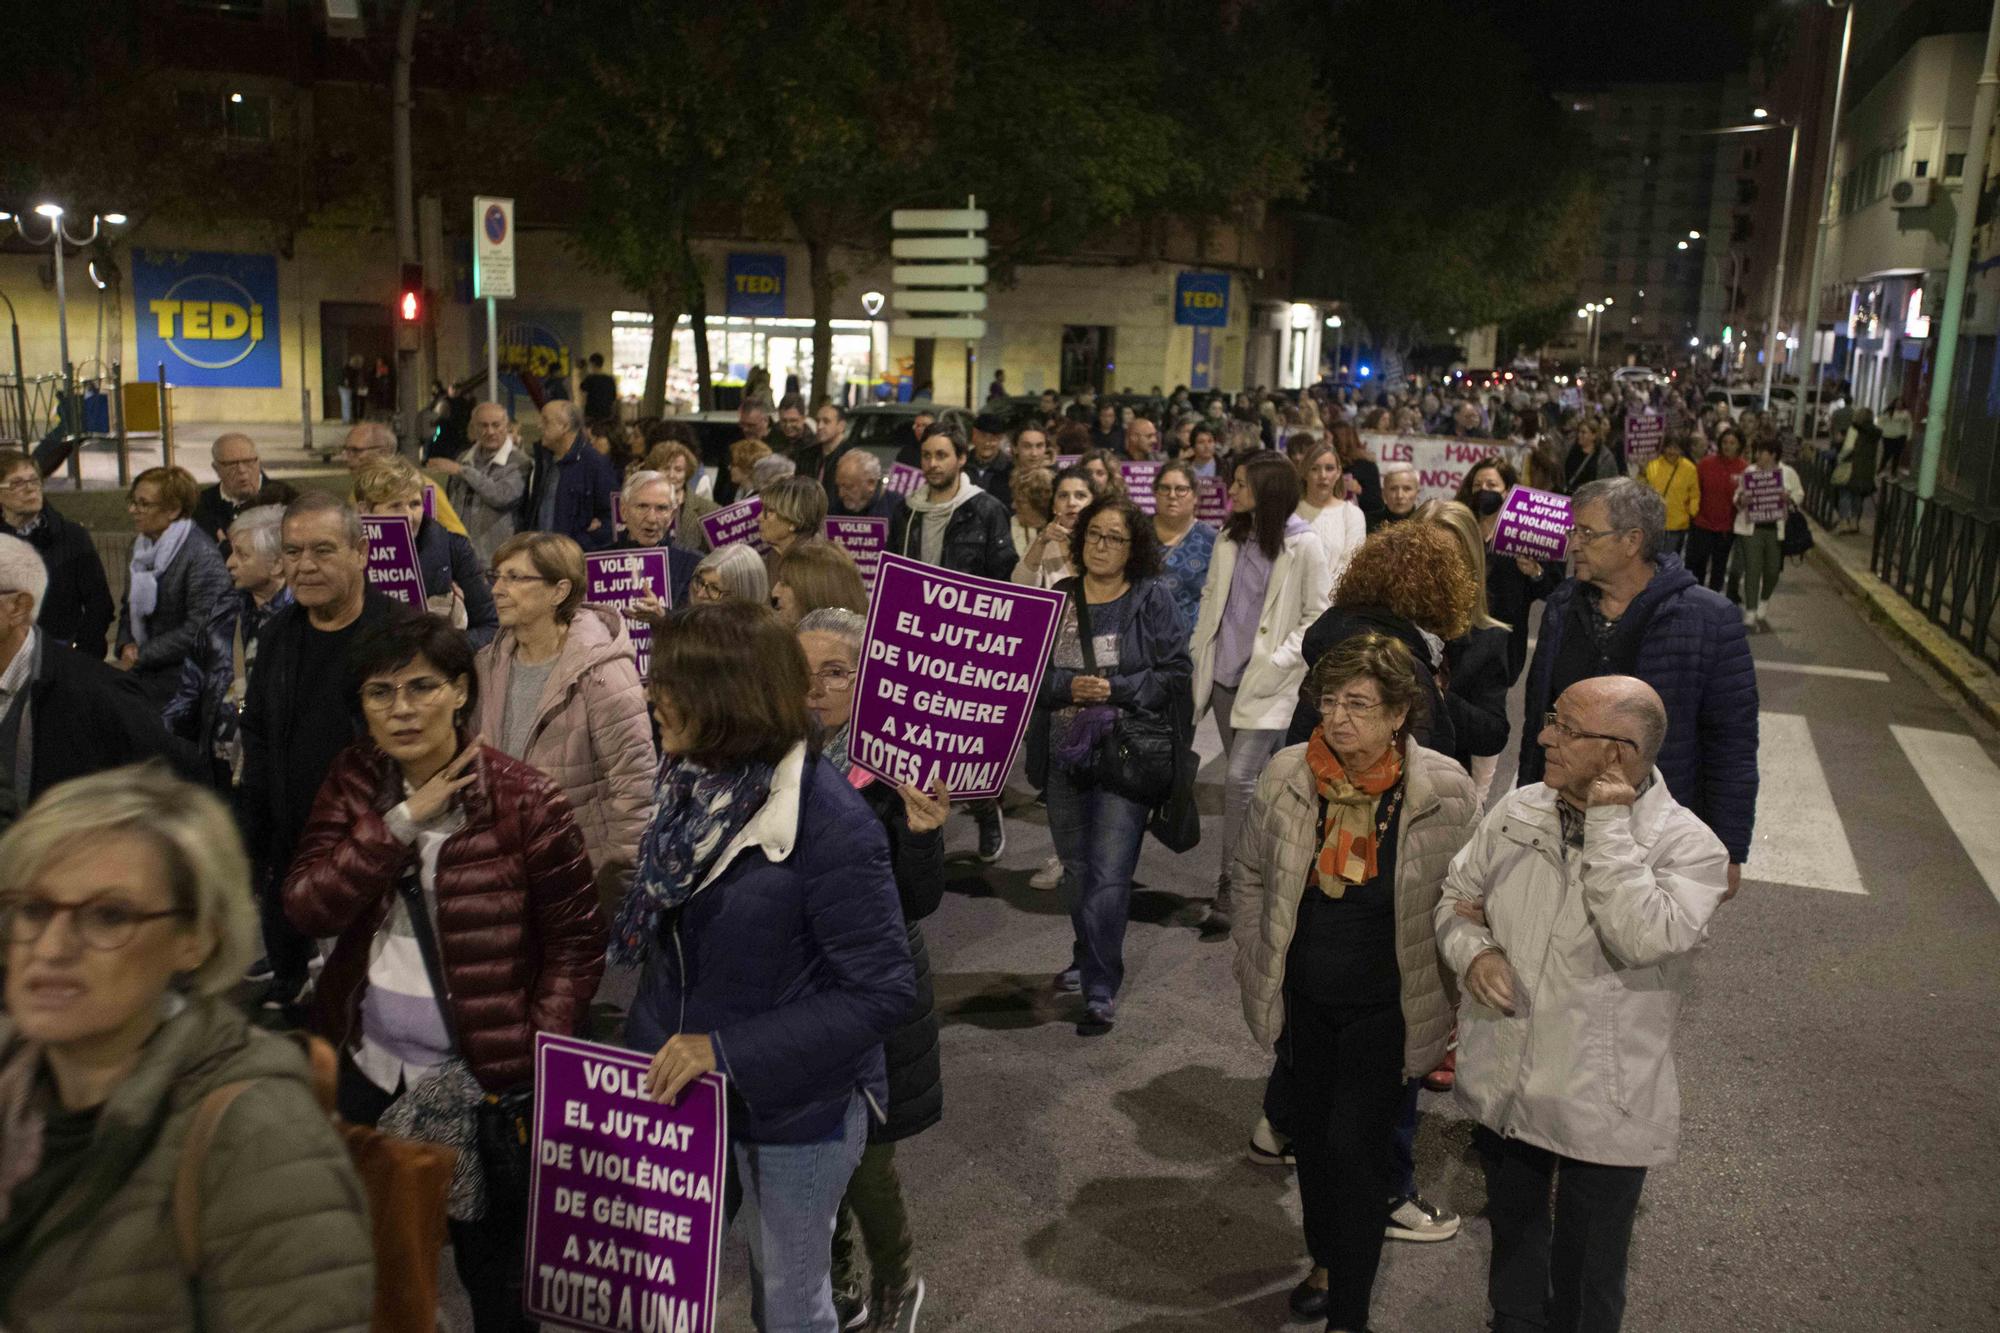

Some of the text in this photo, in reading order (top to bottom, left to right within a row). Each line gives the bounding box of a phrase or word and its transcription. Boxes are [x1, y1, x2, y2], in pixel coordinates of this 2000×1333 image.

[736, 274, 780, 295] TEDi
[1183, 291, 1224, 308] TEDi
[149, 300, 264, 341] TEDi
[1382, 443, 1413, 462] LES
[1516, 500, 1569, 521] EL JUTJAT
[1529, 493, 1568, 509] VOLEM
[716, 505, 752, 526] VOLEM
[1502, 510, 1518, 522] DE
[716, 529, 730, 542] EL
[838, 522, 872, 534] VOLEM
[1503, 526, 1560, 550] DE GÈNERE
[370, 546, 397, 561] JAT
[847, 536, 879, 547] JUTJAT
[1505, 542, 1513, 551] A
[594, 580, 608, 593] EL
[922, 580, 1015, 621] VOLEM
[895, 611, 1023, 657] EL JUTJAT
[869, 639, 1030, 693] DE VIOLÈNCIA
[877, 678, 1008, 724] DE GÈNERE
[881, 716, 984, 755] A XÀTIVA
[860, 730, 1001, 792] TOTES A UNA!
[582, 1060, 652, 1101] VOLE
[564, 1100, 694, 1153] EL JUTJAT
[542, 1139, 711, 1204] DE VIOLÈNCIA
[554, 1186, 692, 1244] DE GÈNERE
[562, 1233, 676, 1286] A XÀTIVA
[539, 1264, 612, 1326] TOTES
[616, 1284, 633, 1332] A
